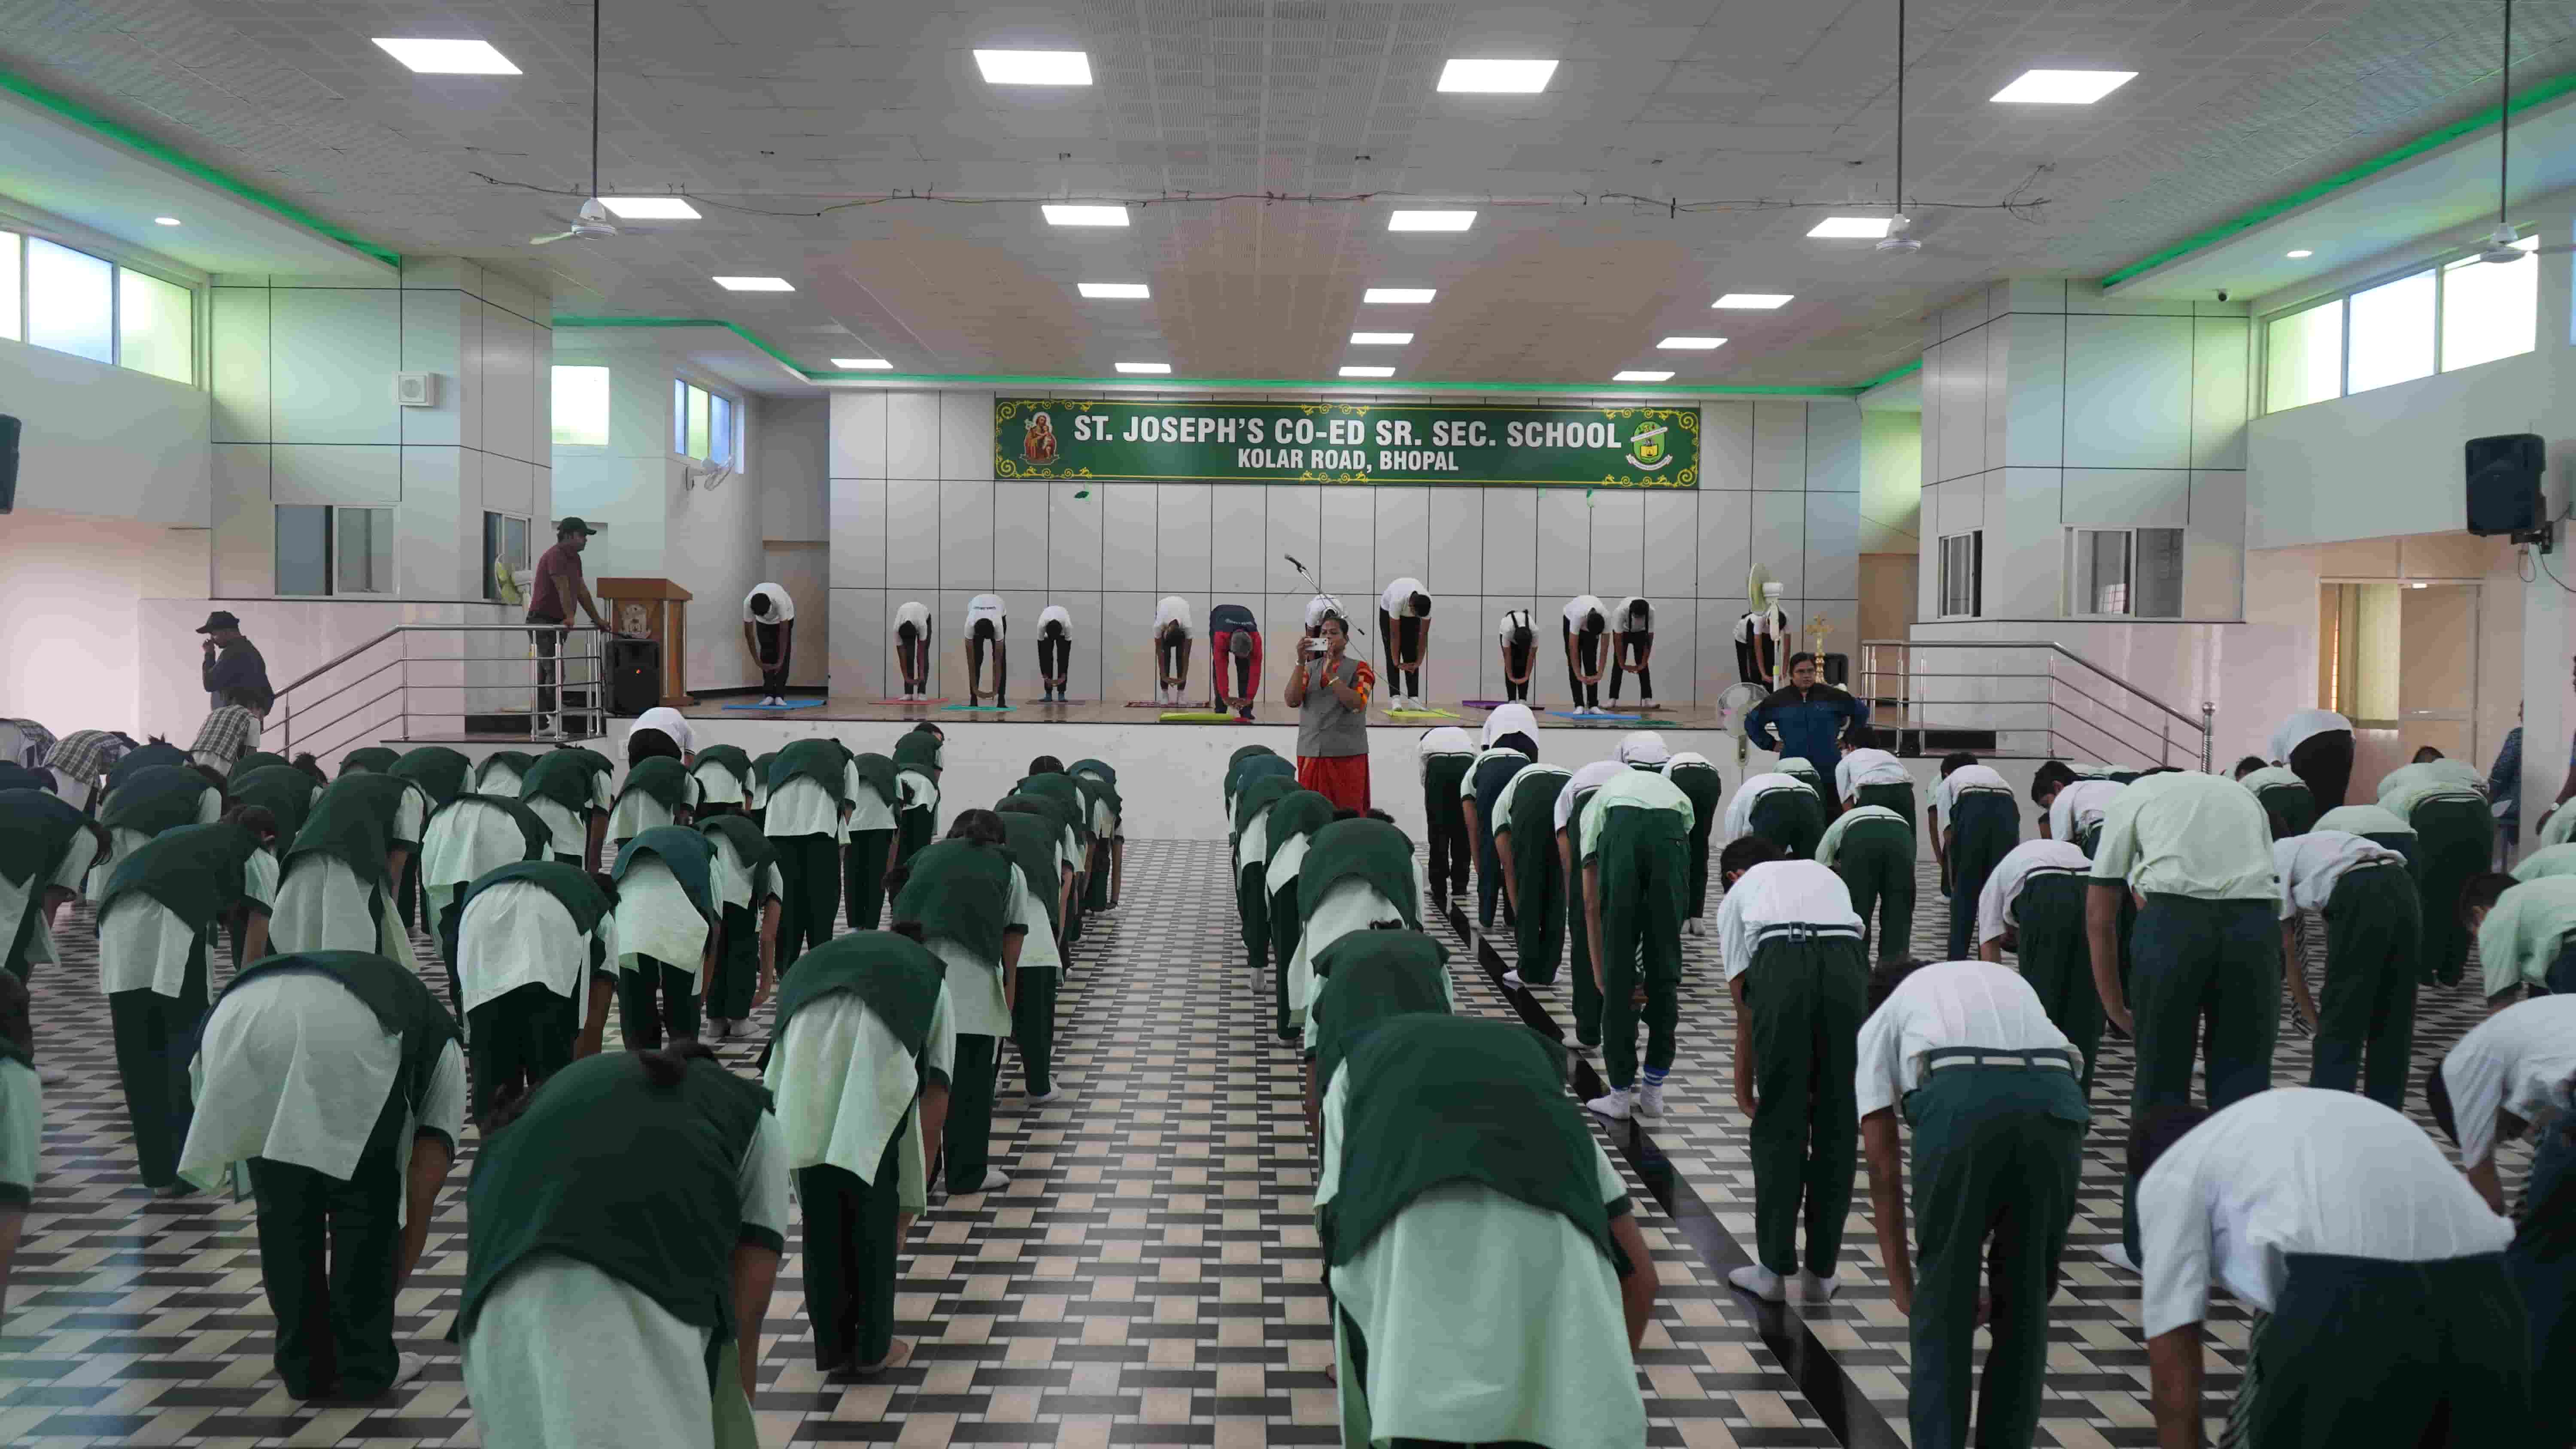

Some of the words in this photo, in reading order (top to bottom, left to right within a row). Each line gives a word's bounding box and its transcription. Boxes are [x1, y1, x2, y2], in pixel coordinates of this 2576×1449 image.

[1074, 415, 1113, 441] ST.
[1123, 416, 1264, 444] JOSEPH'S
[1274, 418, 1365, 445] CO-ED
[1375, 420, 1422, 446] SR.
[1432, 421, 1496, 447] SEC.
[1507, 421, 1622, 449] SCHOOL
[1238, 448, 1304, 468] KOLAR
[1311, 449, 1373, 473] ROAD,
[1379, 451, 1459, 471] BHOPAL
